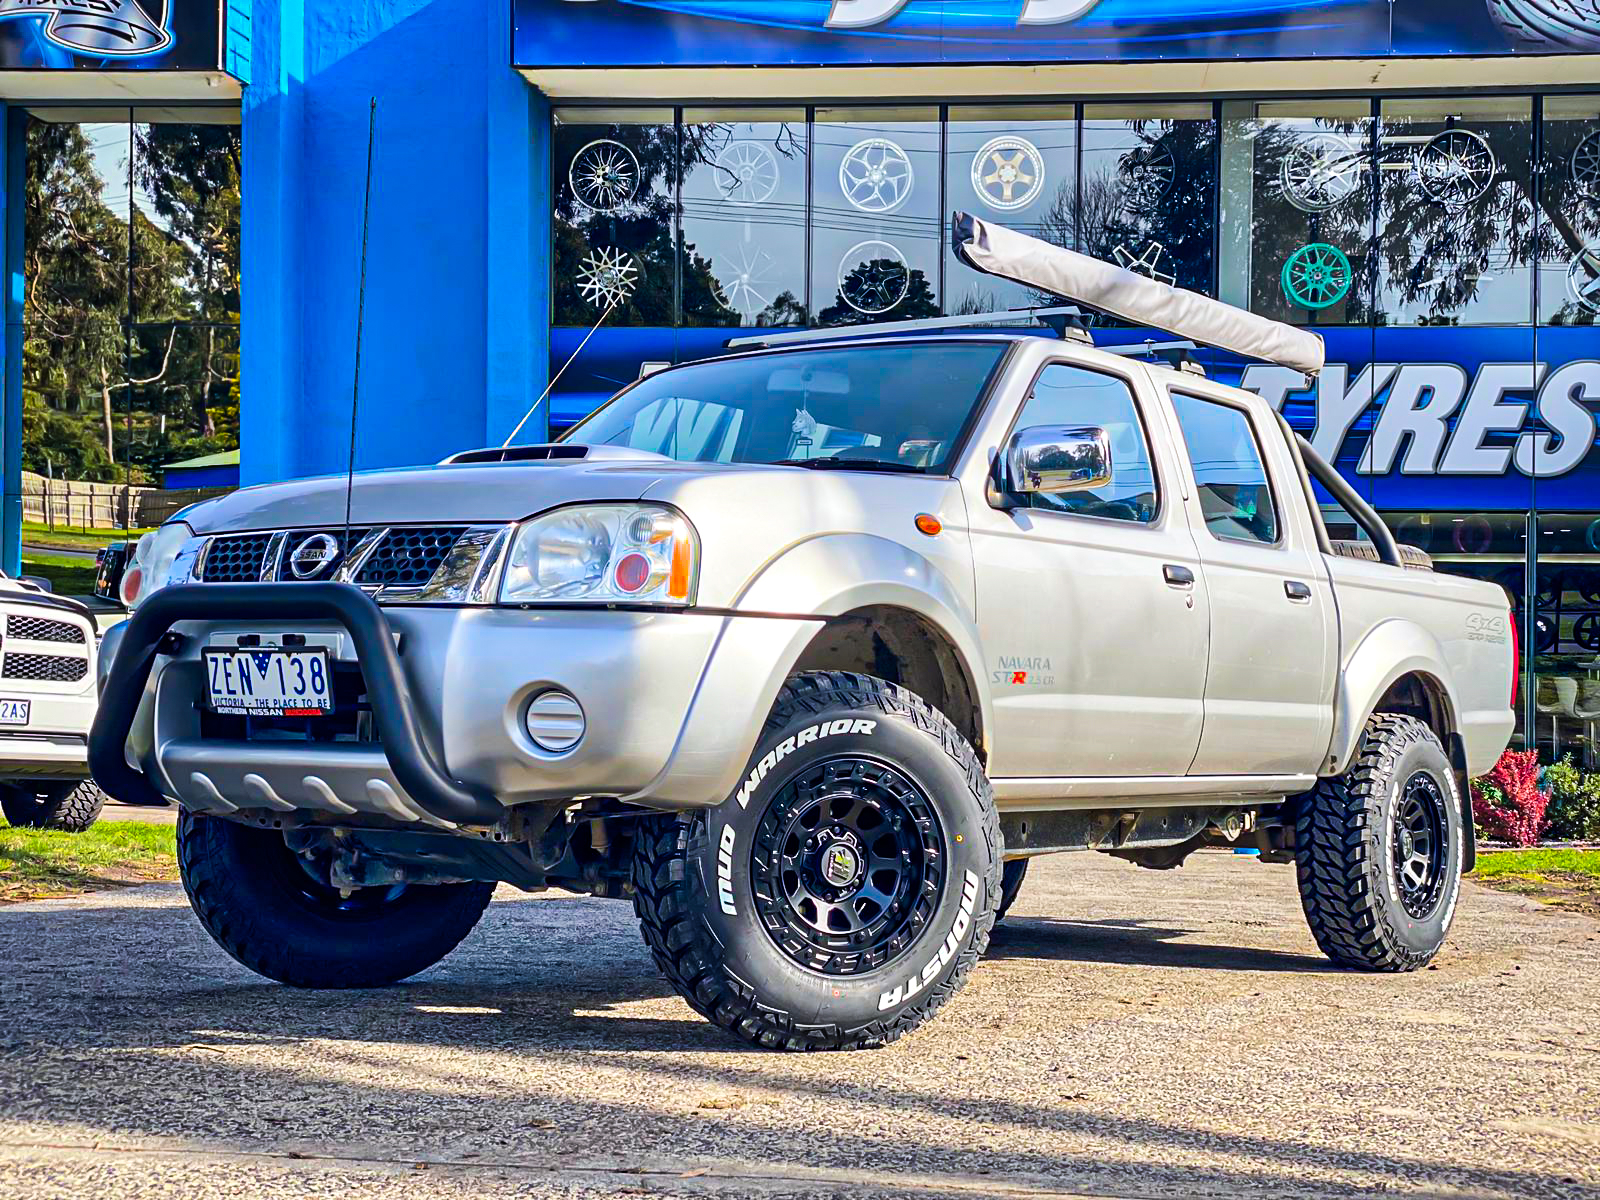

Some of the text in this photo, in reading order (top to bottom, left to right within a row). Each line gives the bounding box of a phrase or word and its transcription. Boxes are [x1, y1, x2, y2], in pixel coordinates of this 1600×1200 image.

[1241, 361, 1600, 477] TYRES
[209, 656, 325, 695] ZEN 138
[998, 656, 1051, 670] NAVARA
[1, 703, 27, 718] 2AS
[213, 698, 245, 707] VICTORIA
[255, 698, 269, 708] THE
[273, 698, 297, 708] PLACE
[301, 698, 313, 708] TO
[318, 698, 328, 708] BE
[248, 708, 283, 716] NISSAN
[717, 718, 877, 916] MUD WARRIOR
[877, 868, 979, 1011] MONSTA
